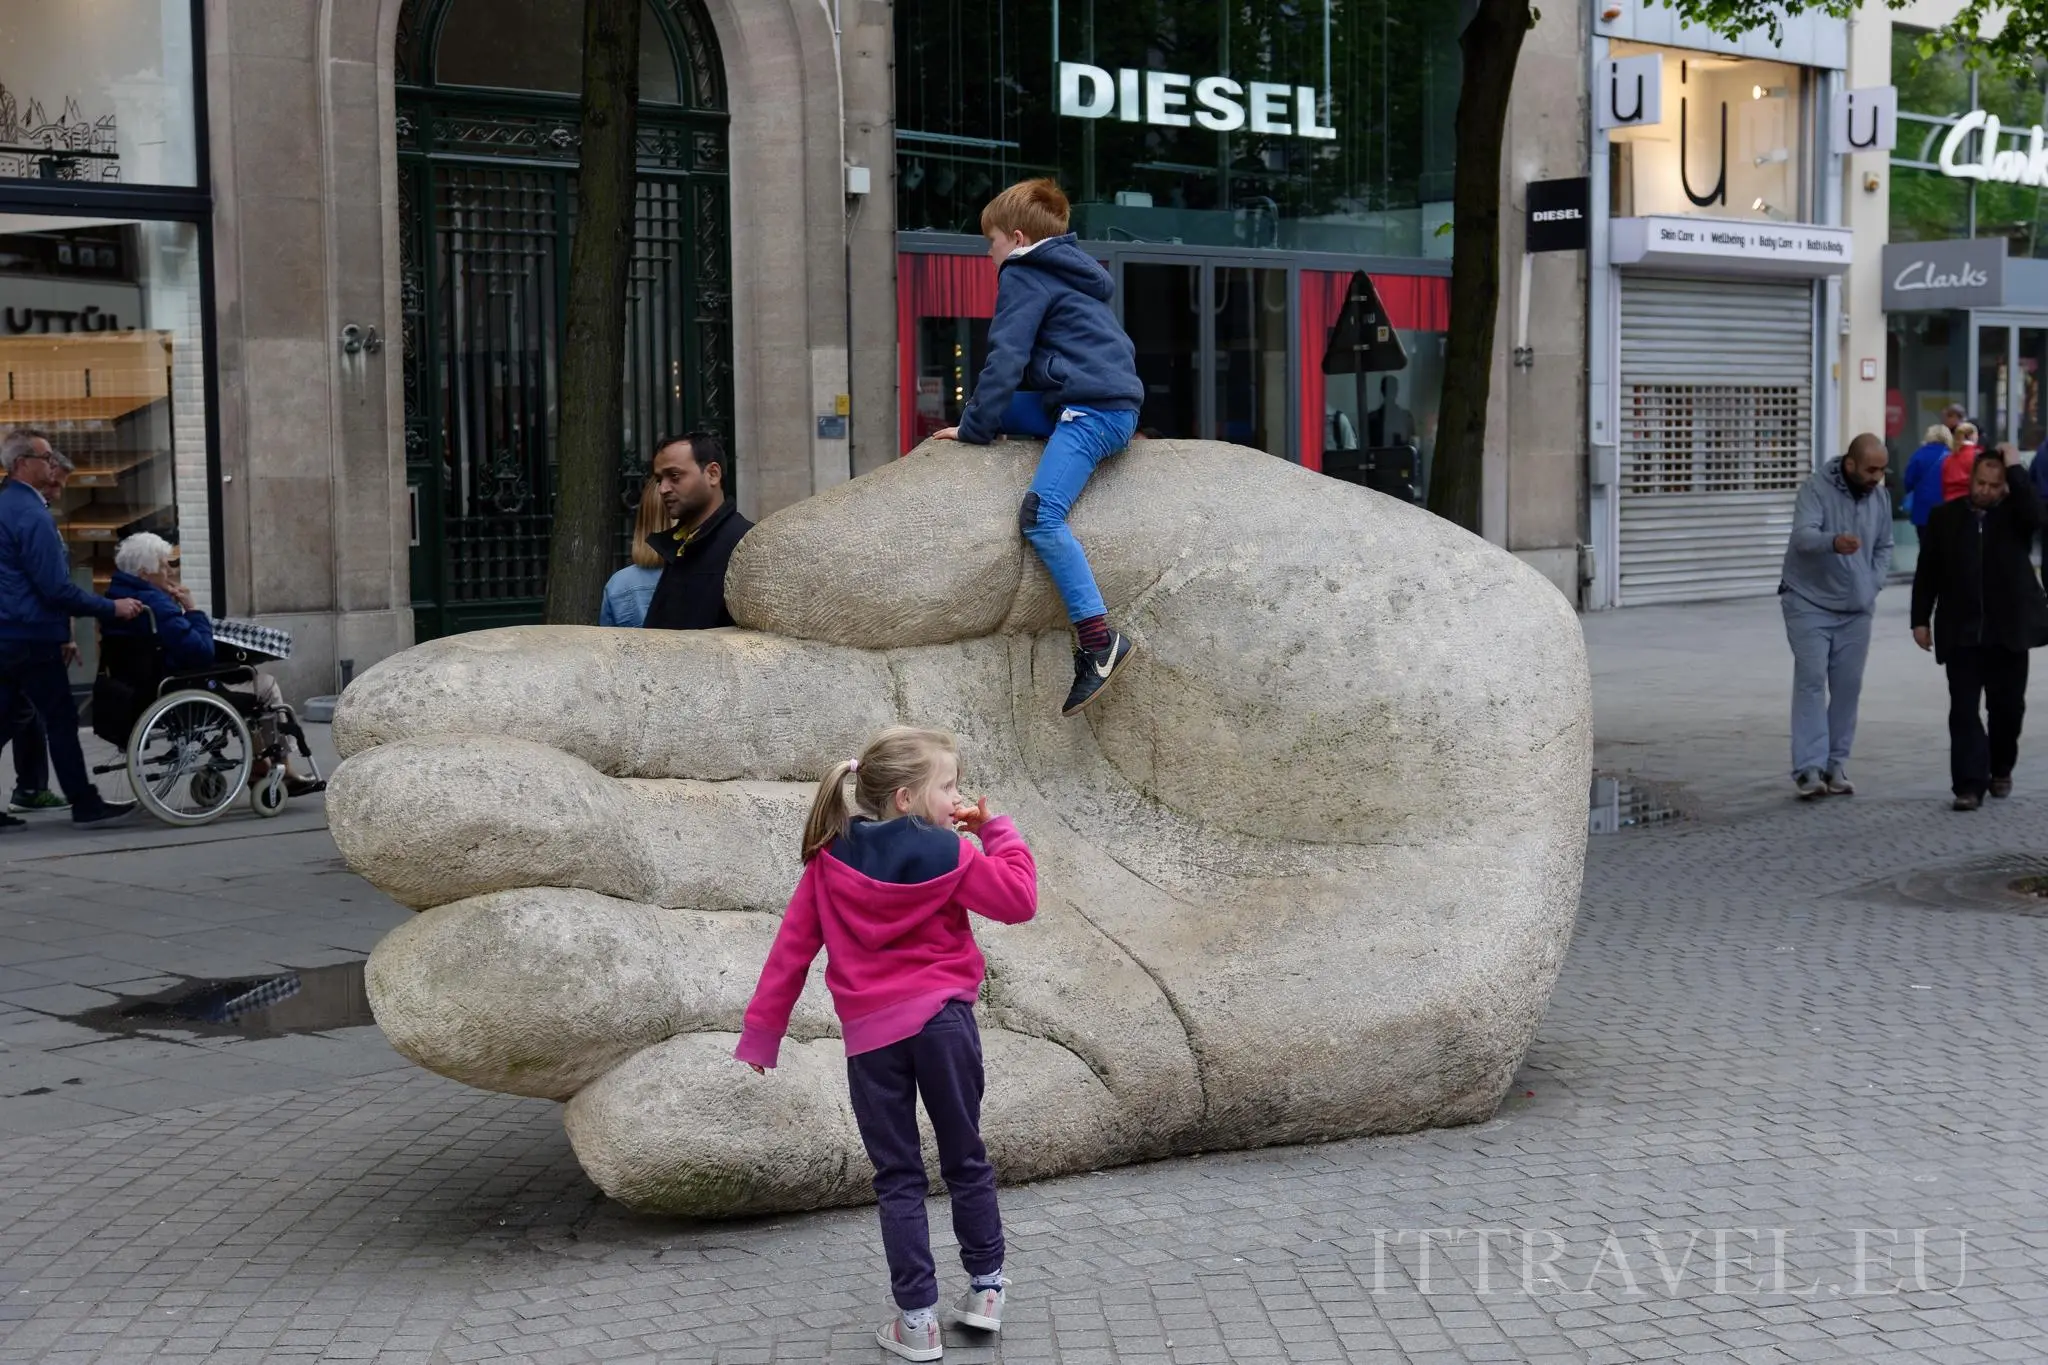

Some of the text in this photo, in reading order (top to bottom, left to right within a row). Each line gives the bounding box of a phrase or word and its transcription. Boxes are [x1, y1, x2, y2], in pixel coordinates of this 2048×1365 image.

[1060, 61, 1336, 139] DIESEL
[1532, 208, 1583, 222] DIESEL
[1661, 228, 1676, 240] Skin
[1678, 230, 1694, 242] Care
[1711, 231, 1745, 248] Wellbeing
[1759, 235, 1776, 251] Baby
[1778, 237, 1793, 248] Care
[1893, 261, 1988, 290] Clarks
